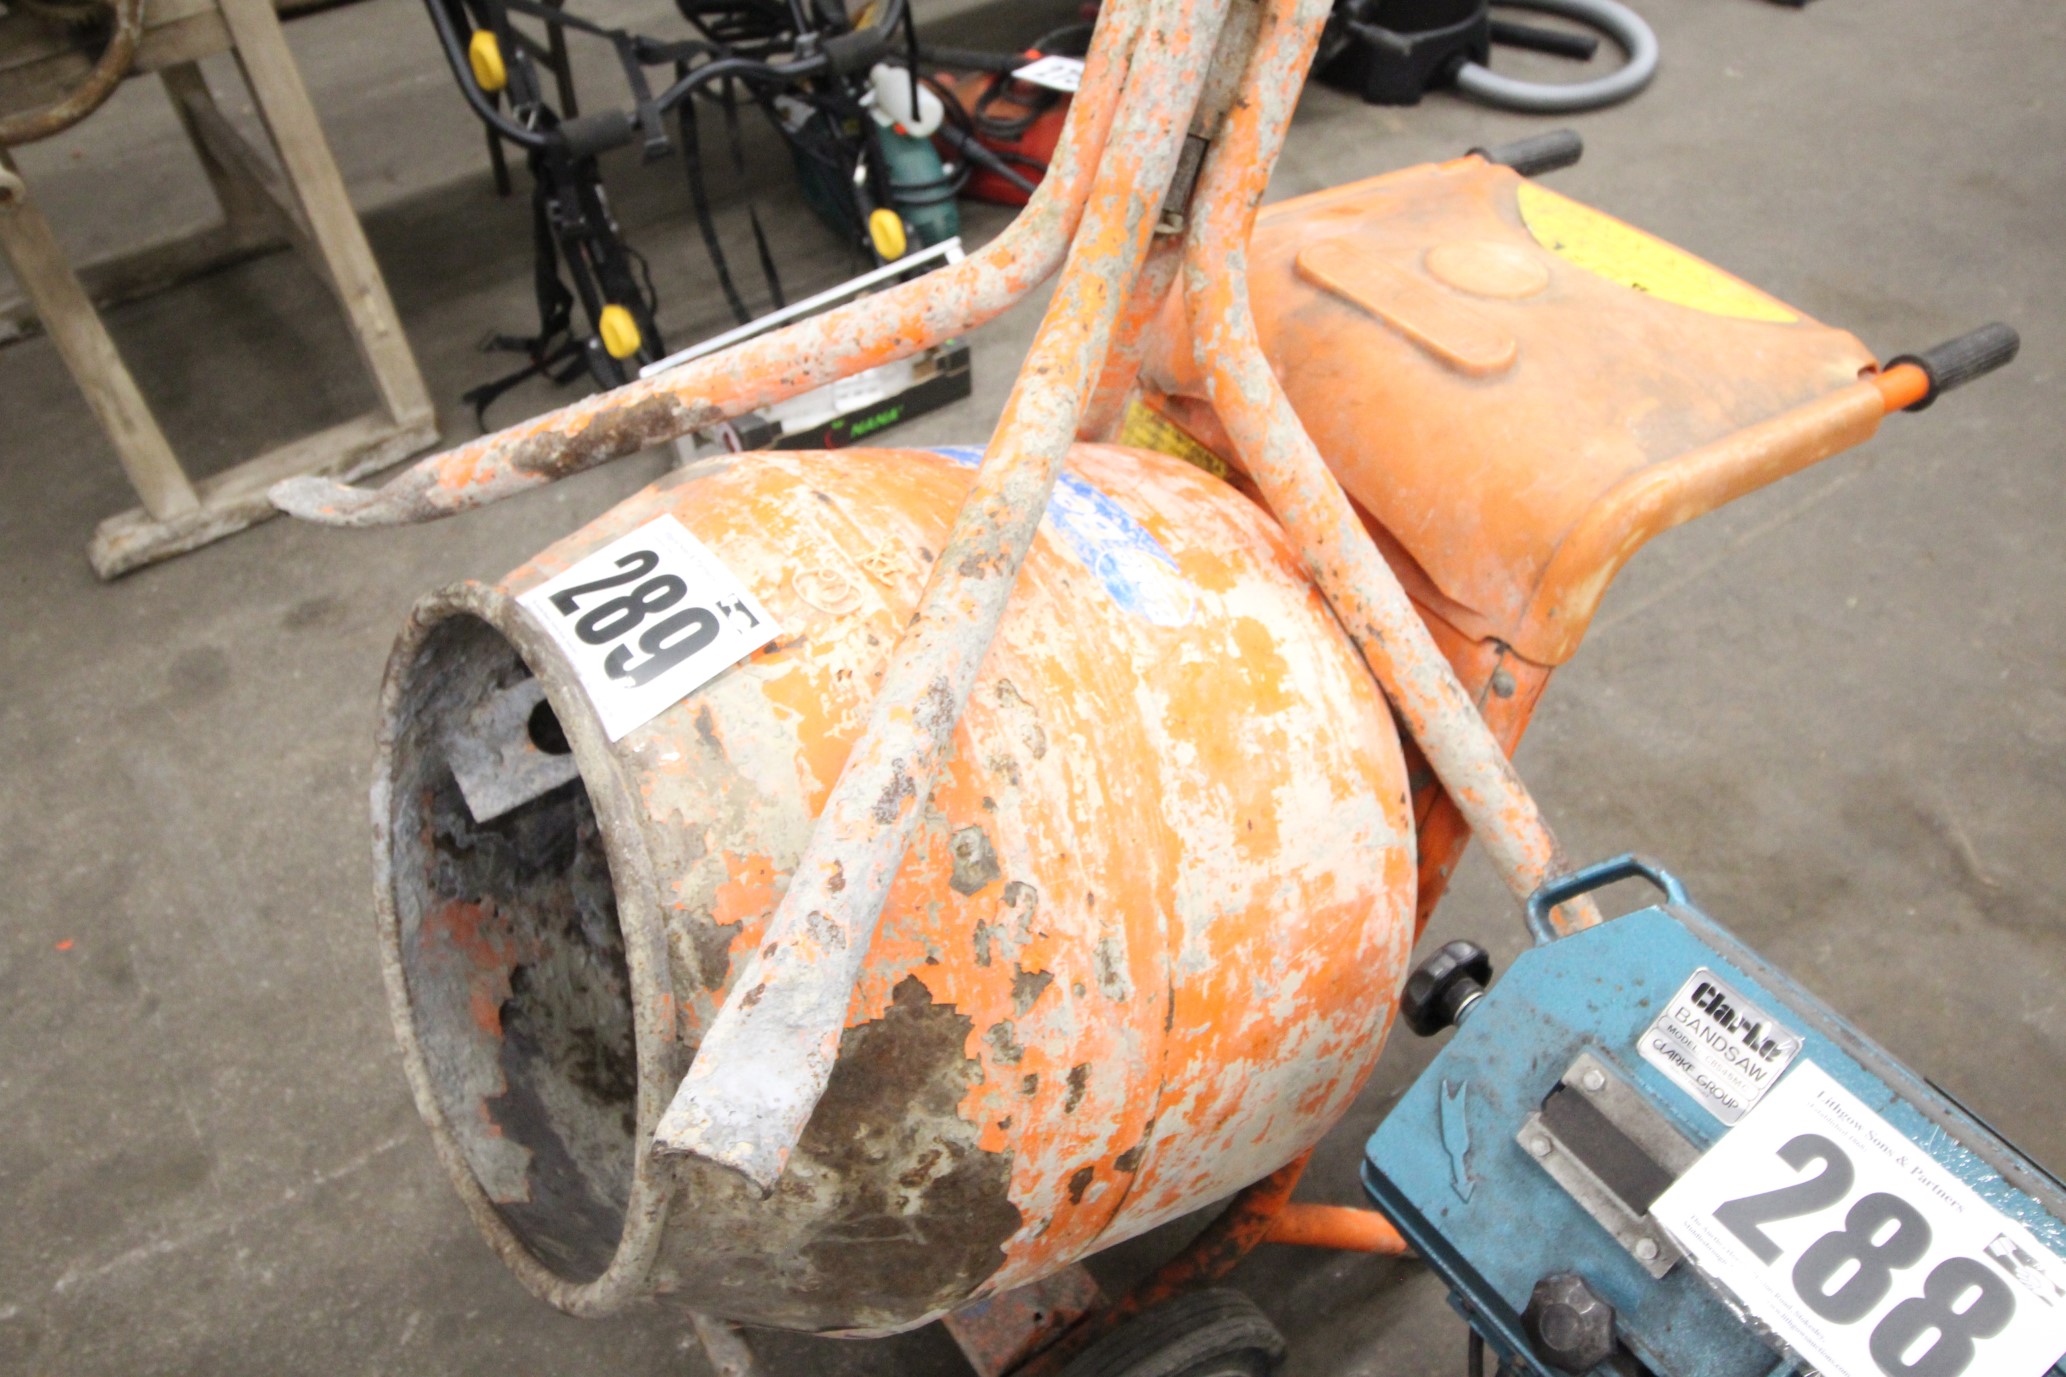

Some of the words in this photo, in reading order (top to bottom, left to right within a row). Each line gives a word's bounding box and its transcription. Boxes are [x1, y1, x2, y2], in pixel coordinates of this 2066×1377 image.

[548, 550, 719, 689] 289
[1675, 1007, 1767, 1082] BANDSAW
[1691, 982, 1781, 1062] Clarke
[1653, 1038, 1695, 1073] CLARKE
[1696, 1074, 1740, 1109] GROUP
[1816, 1090, 1863, 1131] Lithgow
[1865, 1130, 1894, 1157] Sons
[1895, 1155, 1910, 1168] &
[1910, 1166, 1965, 1213] Partners
[1712, 1133, 2016, 1377] 288
